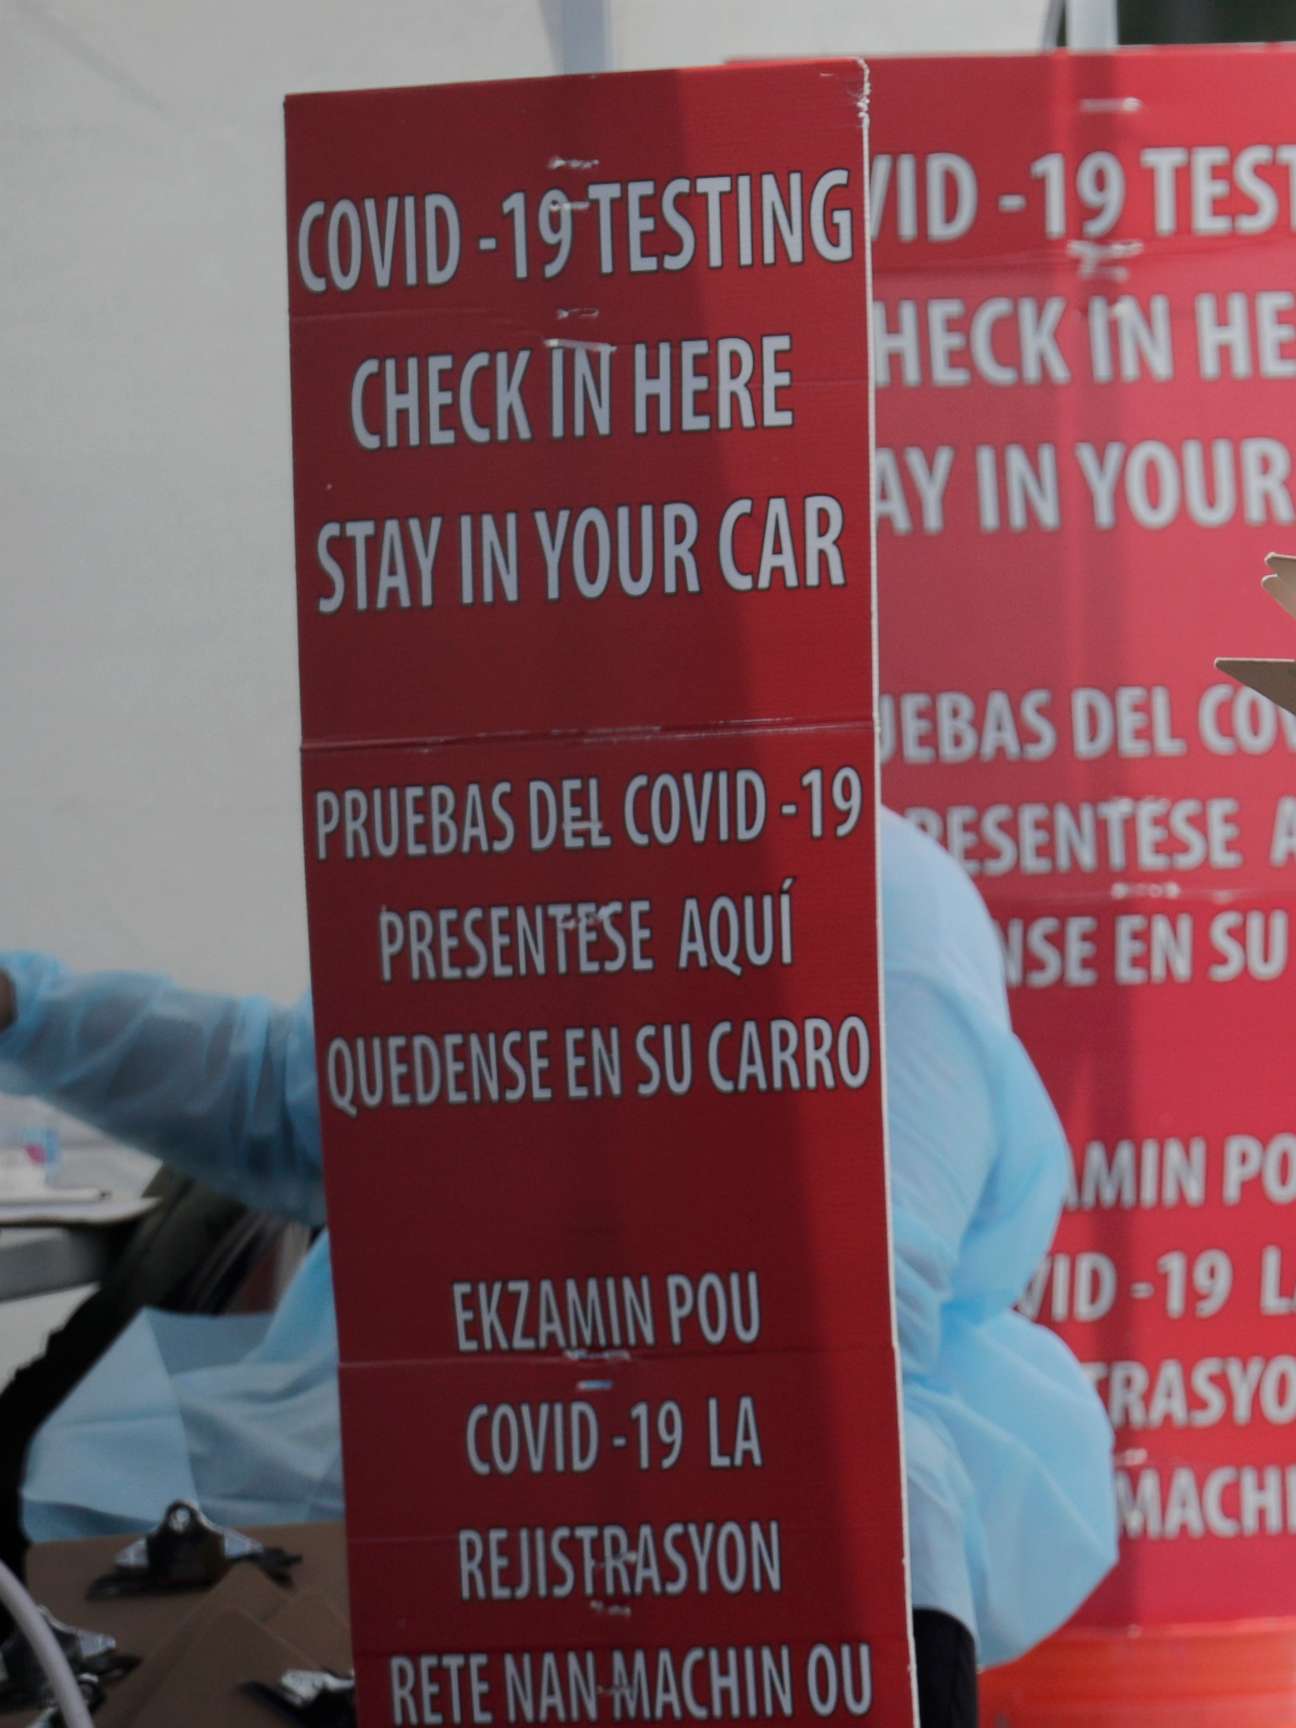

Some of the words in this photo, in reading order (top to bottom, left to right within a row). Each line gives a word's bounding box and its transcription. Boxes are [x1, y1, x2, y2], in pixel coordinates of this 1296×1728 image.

[298, 192, 461, 293] COVID
[478, 187, 573, 279] -19
[587, 168, 855, 275] TESTING
[998, 150, 1127, 240] -19
[873, 294, 1070, 388] HECK
[1089, 292, 1174, 383] IN
[350, 349, 531, 451] CHECK
[549, 343, 611, 440] IN
[633, 333, 794, 437] HERE
[874, 444, 956, 536] AY
[975, 441, 1061, 533] IN
[1075, 436, 1295, 530] YOUR
[316, 515, 443, 615] STAY
[459, 511, 519, 605] IN
[534, 501, 701, 601] YOUR
[718, 494, 846, 592] CAR
[1071, 684, 1186, 758] DEL
[315, 780, 516, 861] PRUEBAS
[528, 776, 612, 851] DEL
[623, 767, 767, 848] COVID
[781, 765, 863, 838] -19
[379, 898, 655, 983] PRESENTESE
[676, 876, 796, 977] AQUÍ
[1114, 913, 1193, 987] EN
[1210, 909, 1288, 982] SU
[326, 1027, 553, 1118] QUEDENSE
[565, 1025, 623, 1099] EN
[635, 1022, 694, 1096] SU
[707, 1015, 871, 1094] CARRO
[452, 1275, 656, 1353] EKZAMIN
[667, 1270, 761, 1346] POU
[1129, 1248, 1233, 1319] -19
[465, 1400, 599, 1476] COVID
[611, 1400, 684, 1470] -19
[707, 1396, 763, 1468] LA
[458, 1520, 782, 1601] REJISTRASYON
[389, 1653, 493, 1728] RETE
[504, 1650, 598, 1724] NAN
[611, 1644, 793, 1723] MACHIN
[805, 1643, 872, 1717] OU
